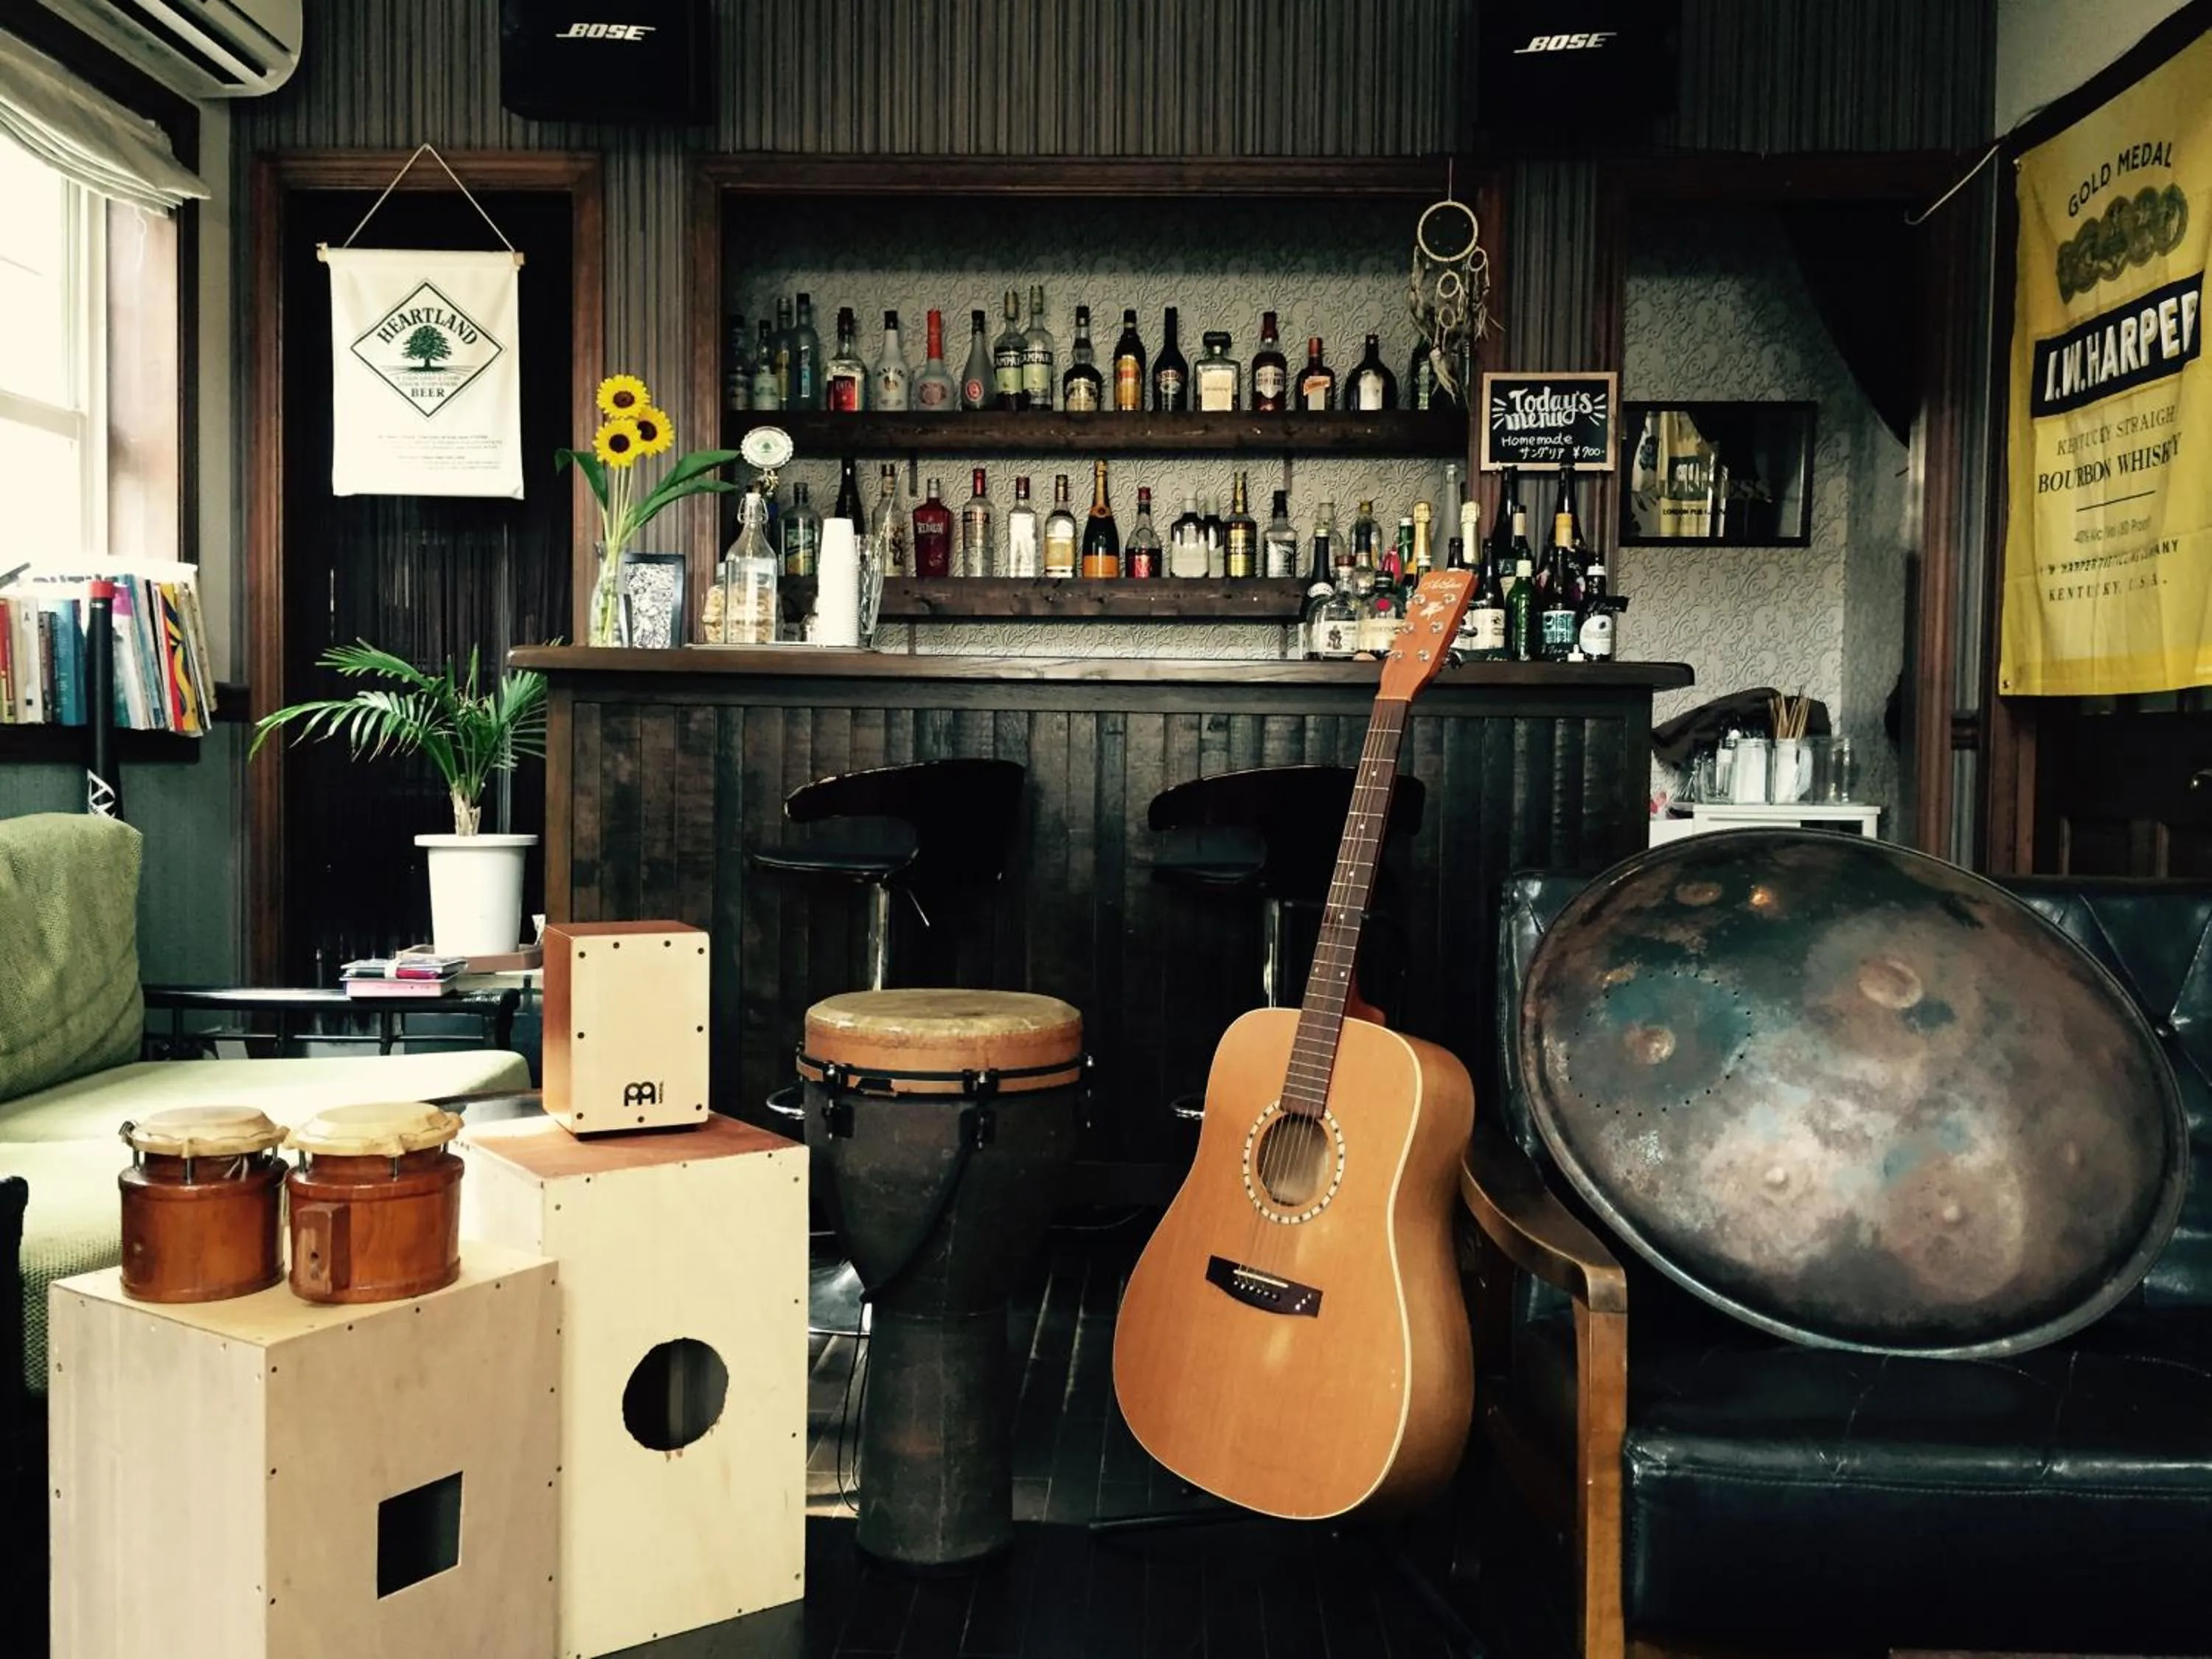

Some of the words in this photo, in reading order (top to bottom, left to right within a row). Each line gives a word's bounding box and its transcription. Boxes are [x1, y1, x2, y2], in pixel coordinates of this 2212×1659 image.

[555, 23, 655, 41] BOSE
[1513, 32, 1618, 54] BOSE
[2067, 163, 2112, 218] GOLD
[2117, 141, 2174, 177] MEDAL
[377, 307, 478, 345] HEARTLAND
[411, 387, 445, 397] BEER
[1508, 386, 1593, 425] Today's
[1504, 411, 1565, 431] menu
[2117, 405, 2176, 438] STRAIGH
[1501, 432, 1573, 447] Homemade
[1519, 446, 1565, 459] サングリア
[2038, 458, 2112, 494] BOURBON
